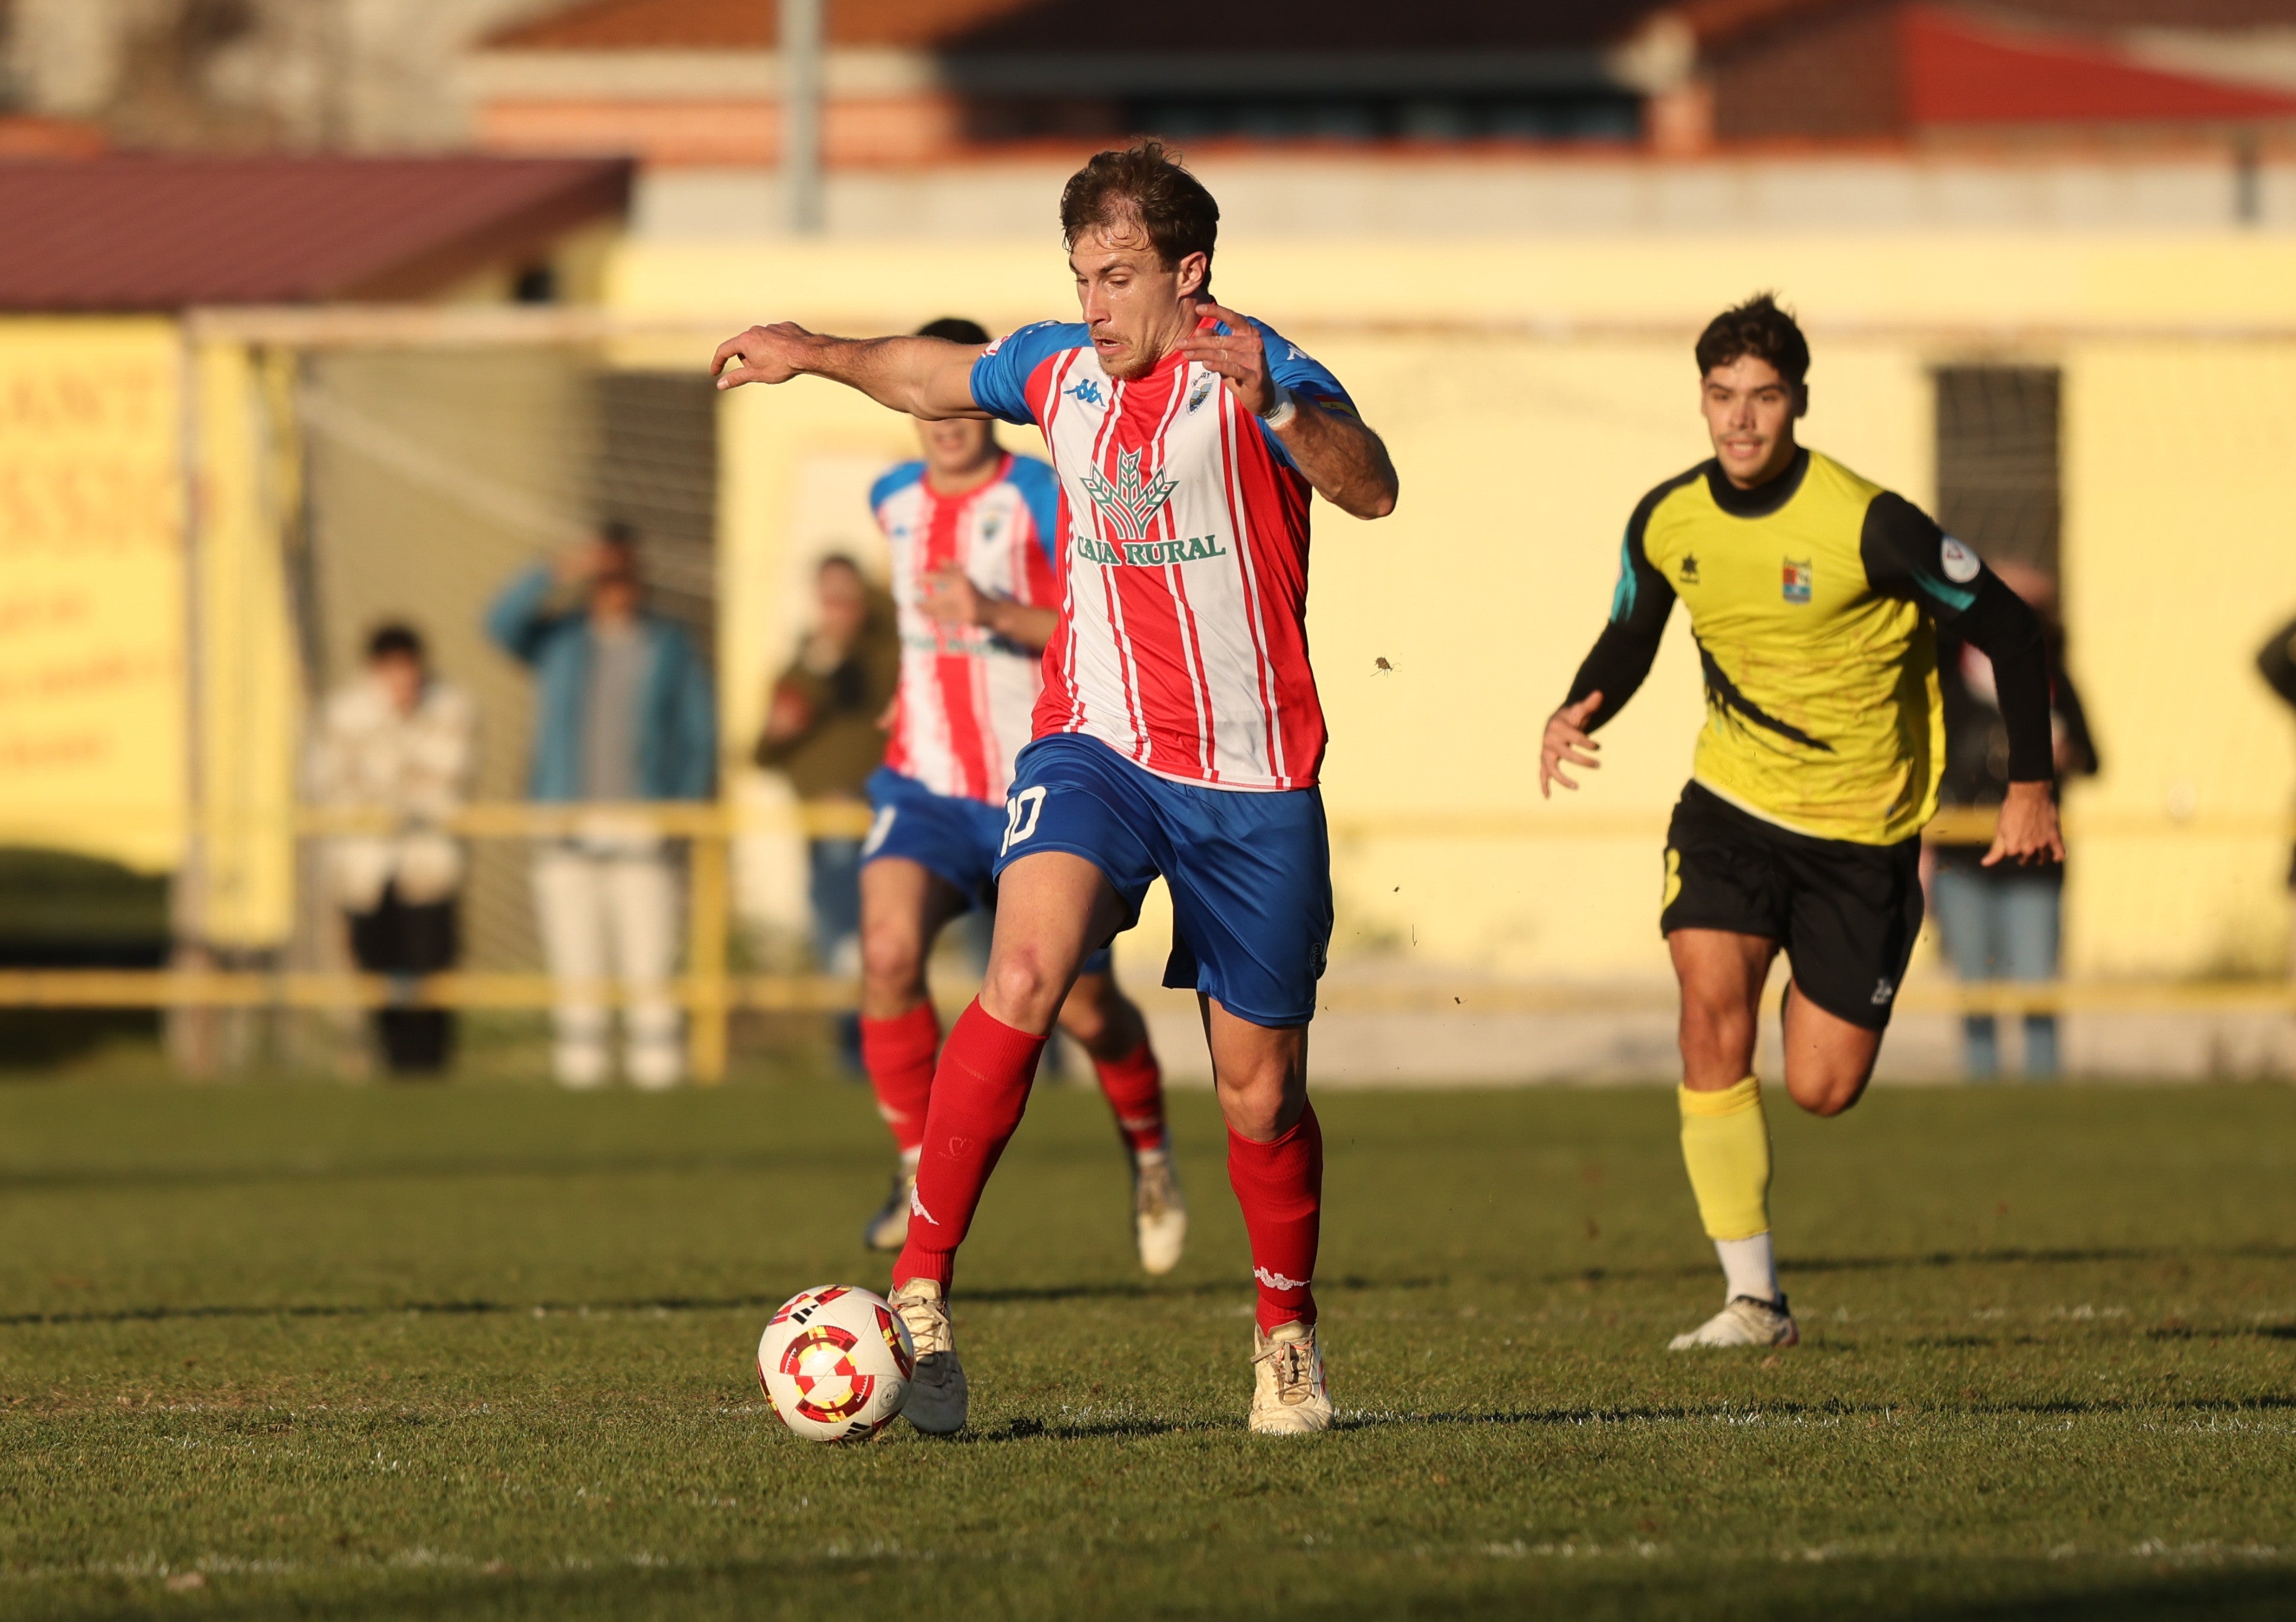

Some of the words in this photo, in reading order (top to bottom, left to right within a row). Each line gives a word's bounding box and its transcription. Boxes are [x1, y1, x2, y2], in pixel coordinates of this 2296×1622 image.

[1077, 535, 1121, 565] CAJA
[1123, 534, 1227, 565] RURAL
[1000, 786, 1047, 858] 10
